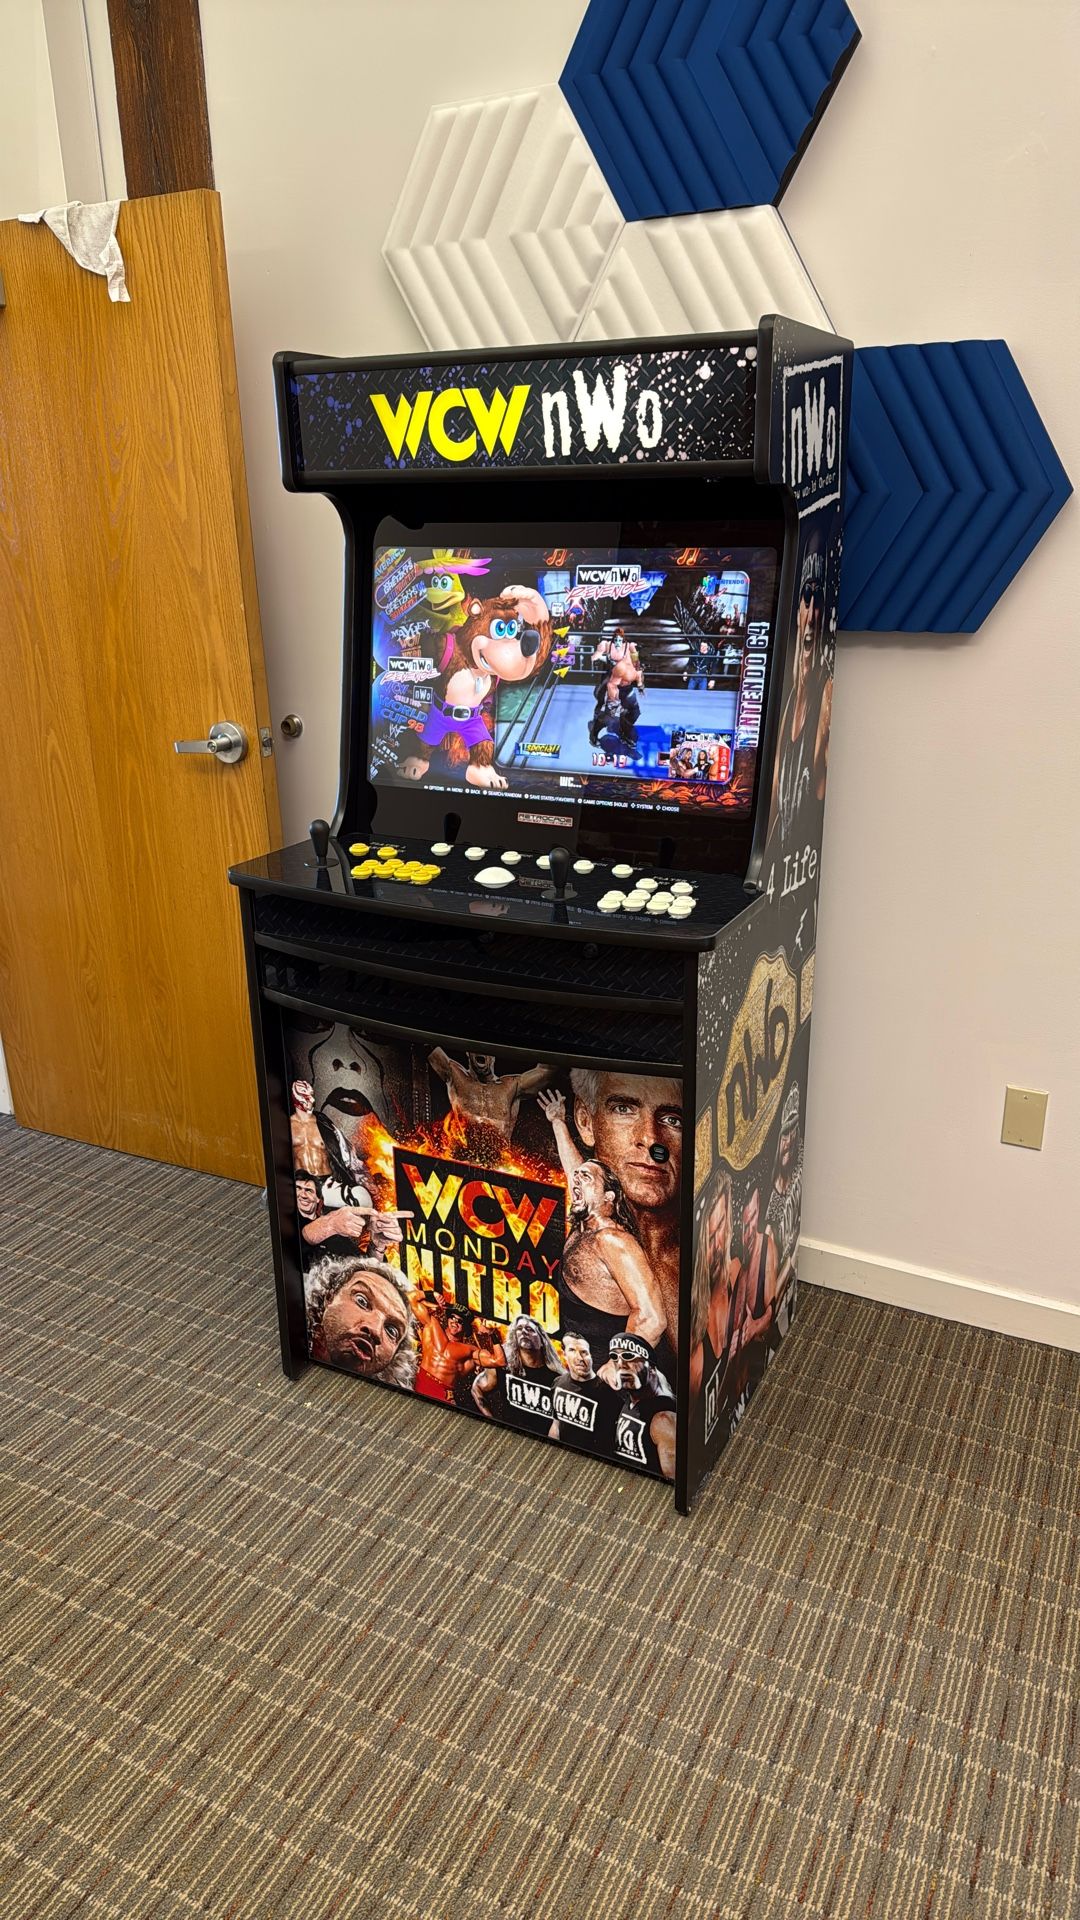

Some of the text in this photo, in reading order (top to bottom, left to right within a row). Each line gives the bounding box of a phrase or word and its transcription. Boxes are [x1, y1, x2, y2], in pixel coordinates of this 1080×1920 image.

[370, 365, 663, 461] WCW nWo
[790, 377, 836, 487] nWo
[579, 570, 611, 582] WCW
[737, 621, 770, 749] NINTENDO 64
[408, 719, 424, 733] 98
[766, 845, 817, 904] 4 Life
[401, 1162, 559, 1249] WCW
[406, 1219, 560, 1279] MONDAY
[405, 1244, 560, 1335] NITRO
[511, 1383, 551, 1411] nWo
[556, 1394, 589, 1422] nWo
